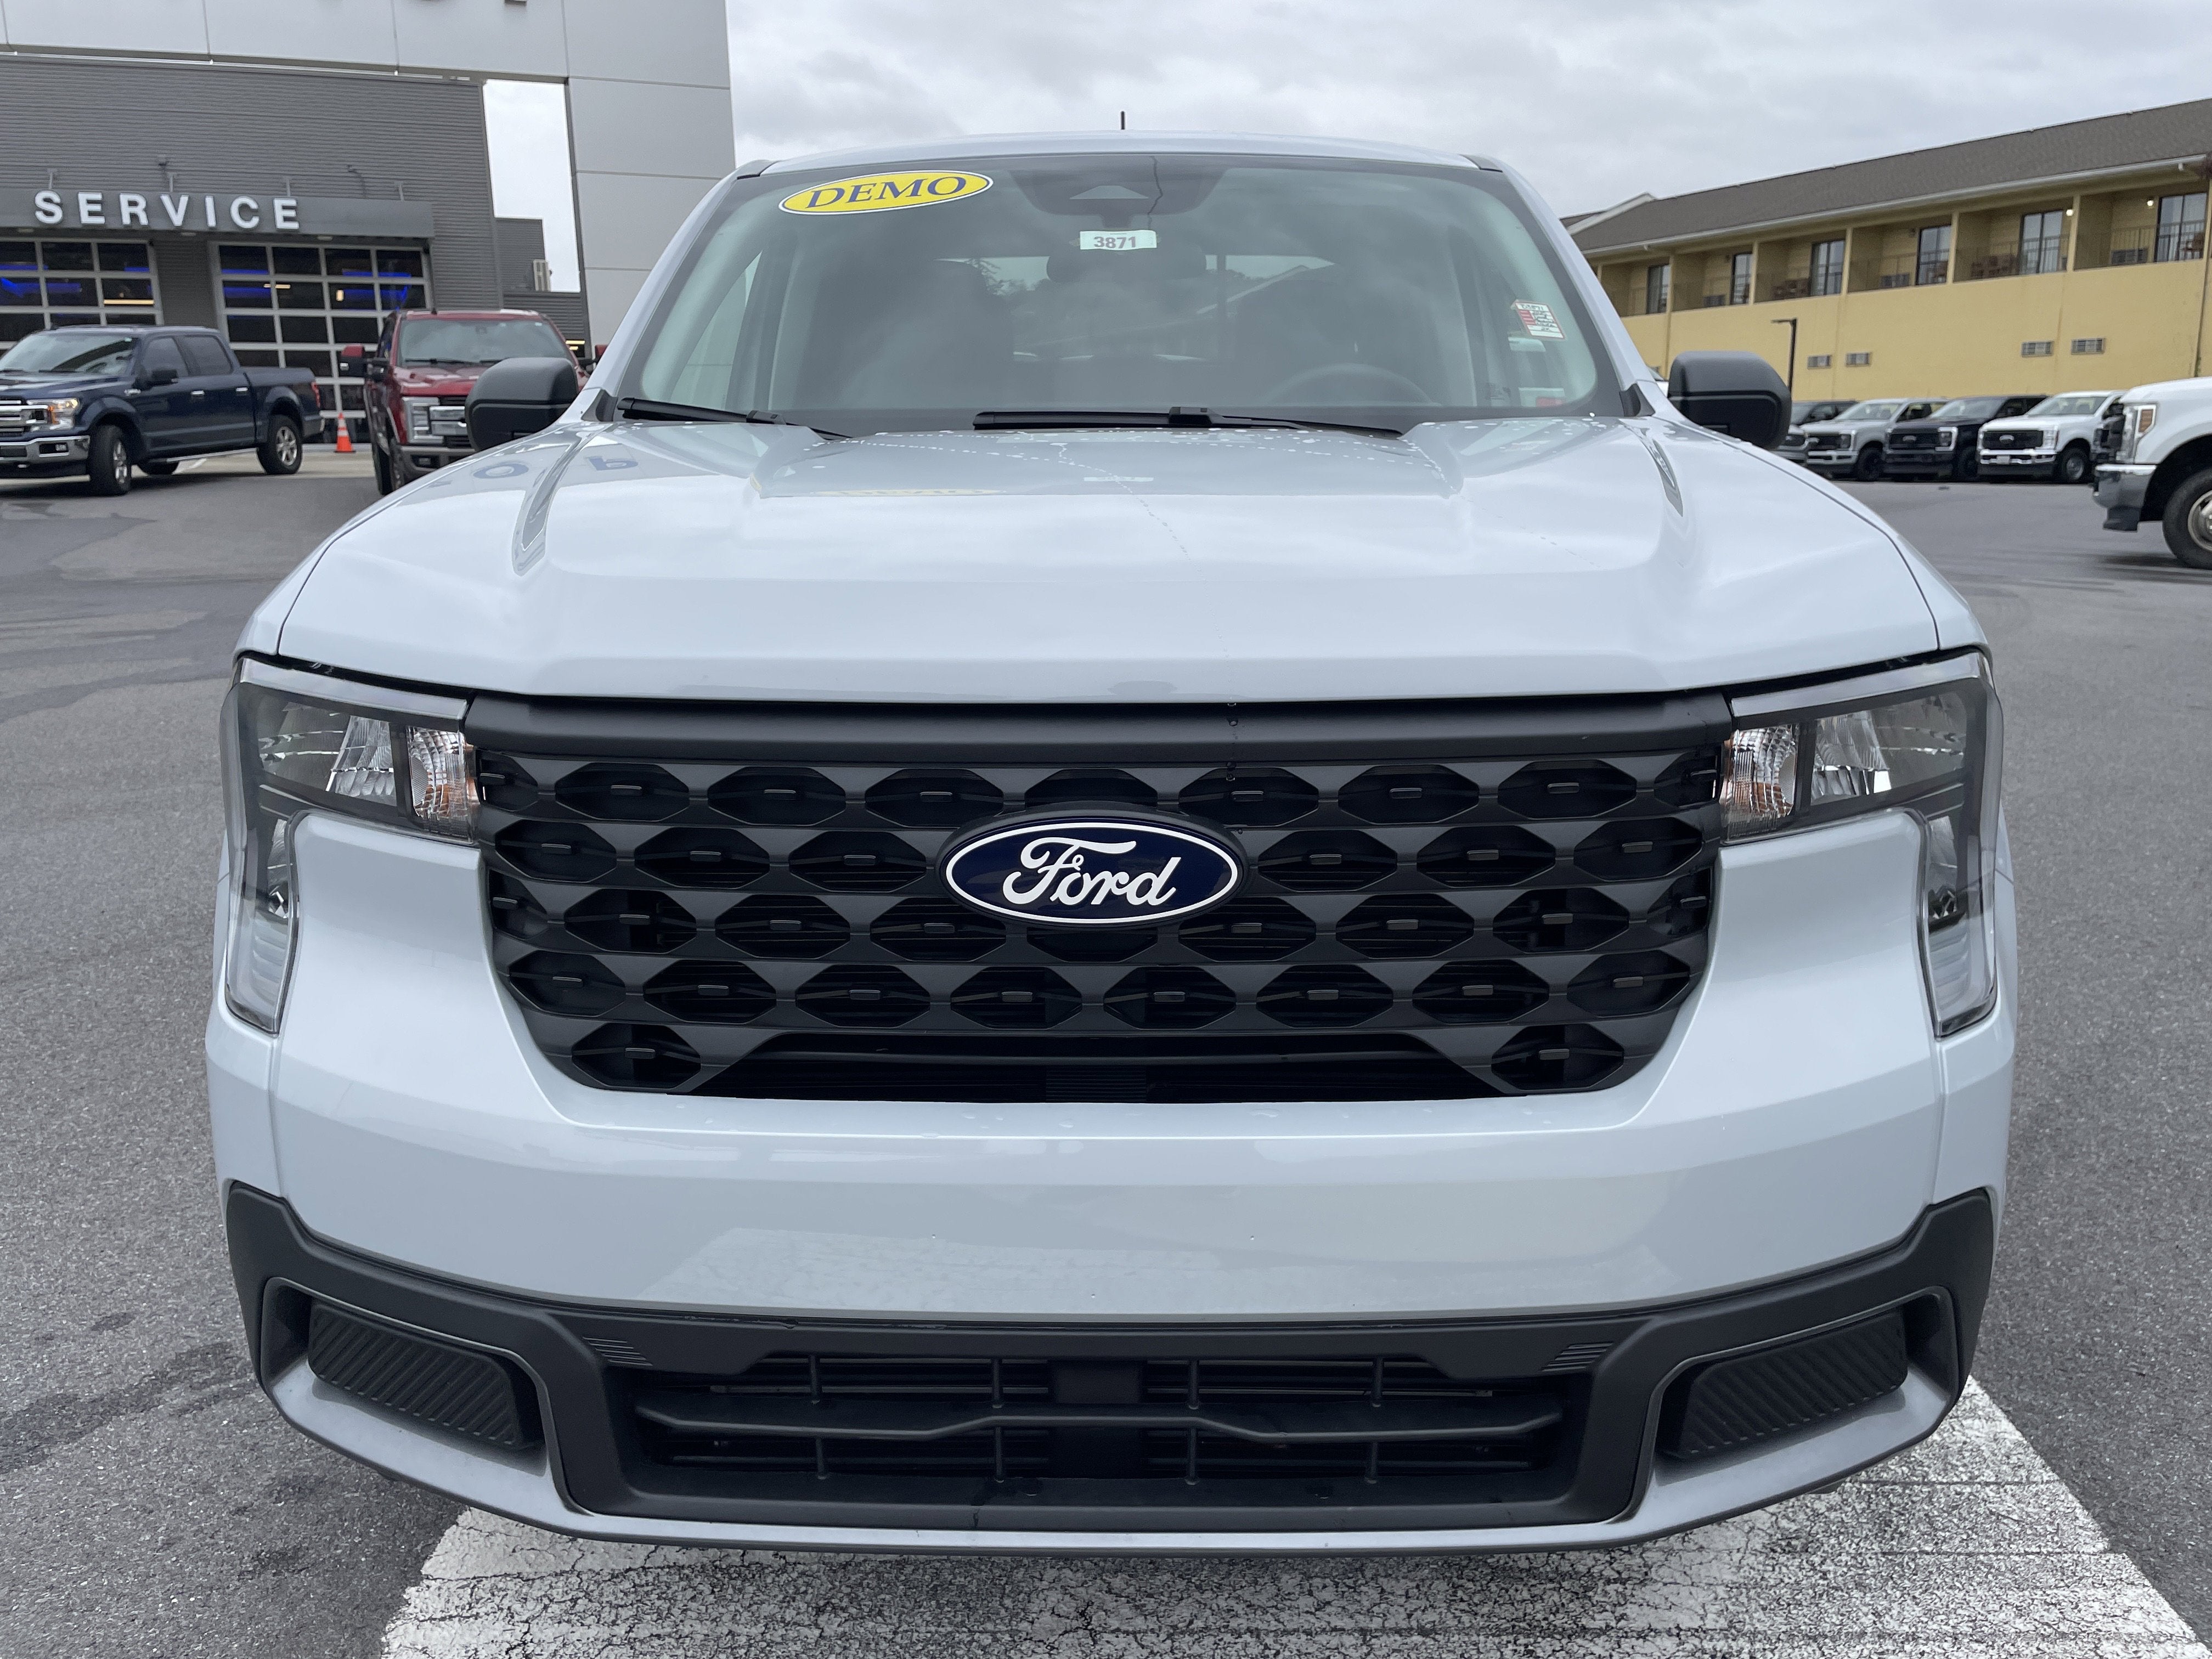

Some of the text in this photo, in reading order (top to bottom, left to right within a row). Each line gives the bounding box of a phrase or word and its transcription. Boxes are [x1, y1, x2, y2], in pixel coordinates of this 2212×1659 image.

[34, 190, 300, 230] SERVICE
[805, 177, 966, 208] DEMO
[1093, 236, 1137, 249] 3871
[1003, 837, 1181, 905] Ford
